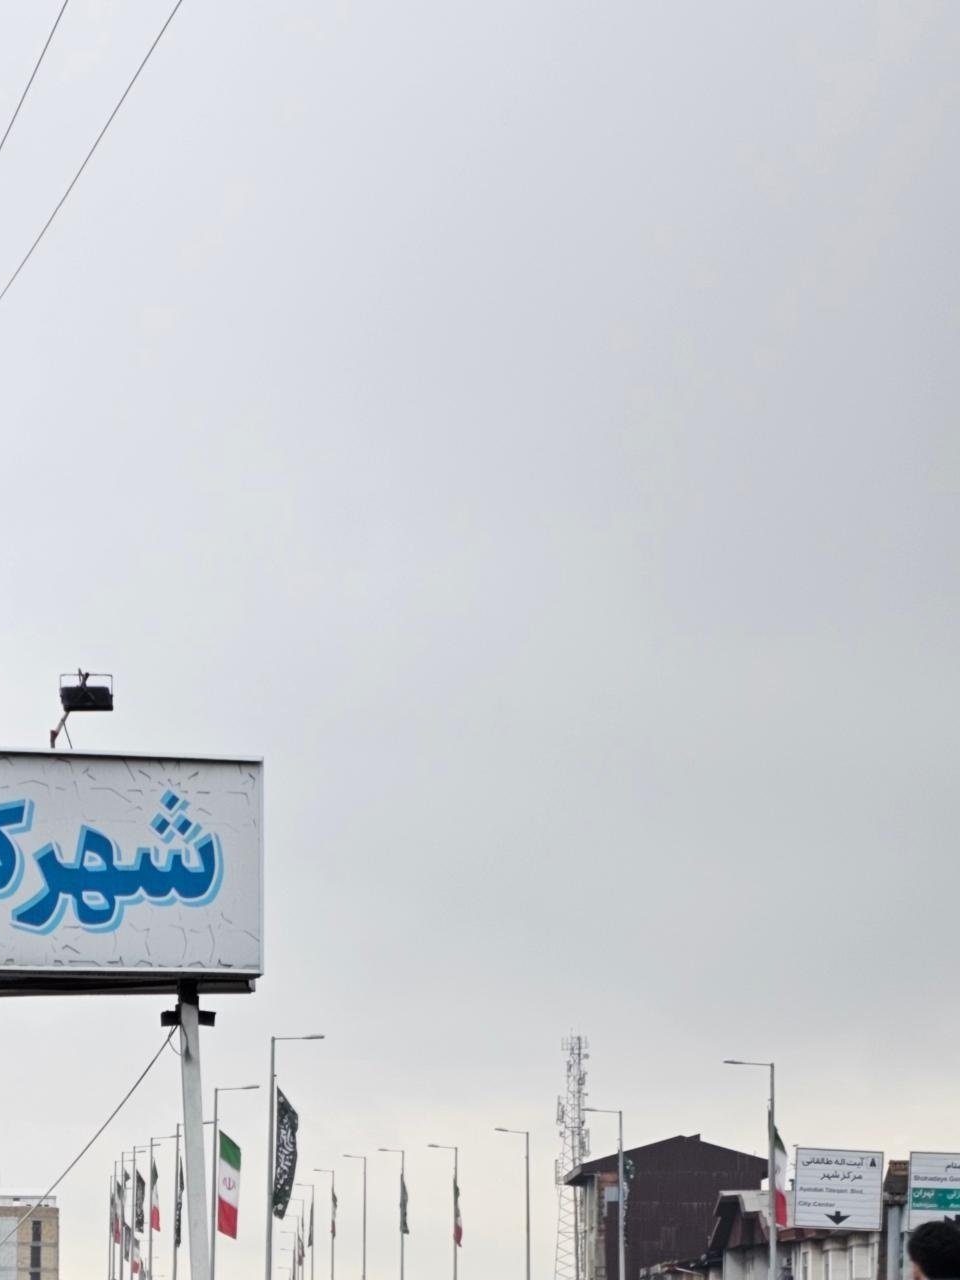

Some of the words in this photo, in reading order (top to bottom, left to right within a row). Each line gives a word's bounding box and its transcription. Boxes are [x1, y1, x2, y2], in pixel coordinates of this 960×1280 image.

[820, 1170, 840, 1181] شهر
[839, 1171, 863, 1183] مرکز
[912, 1189, 935, 1199] تهران
